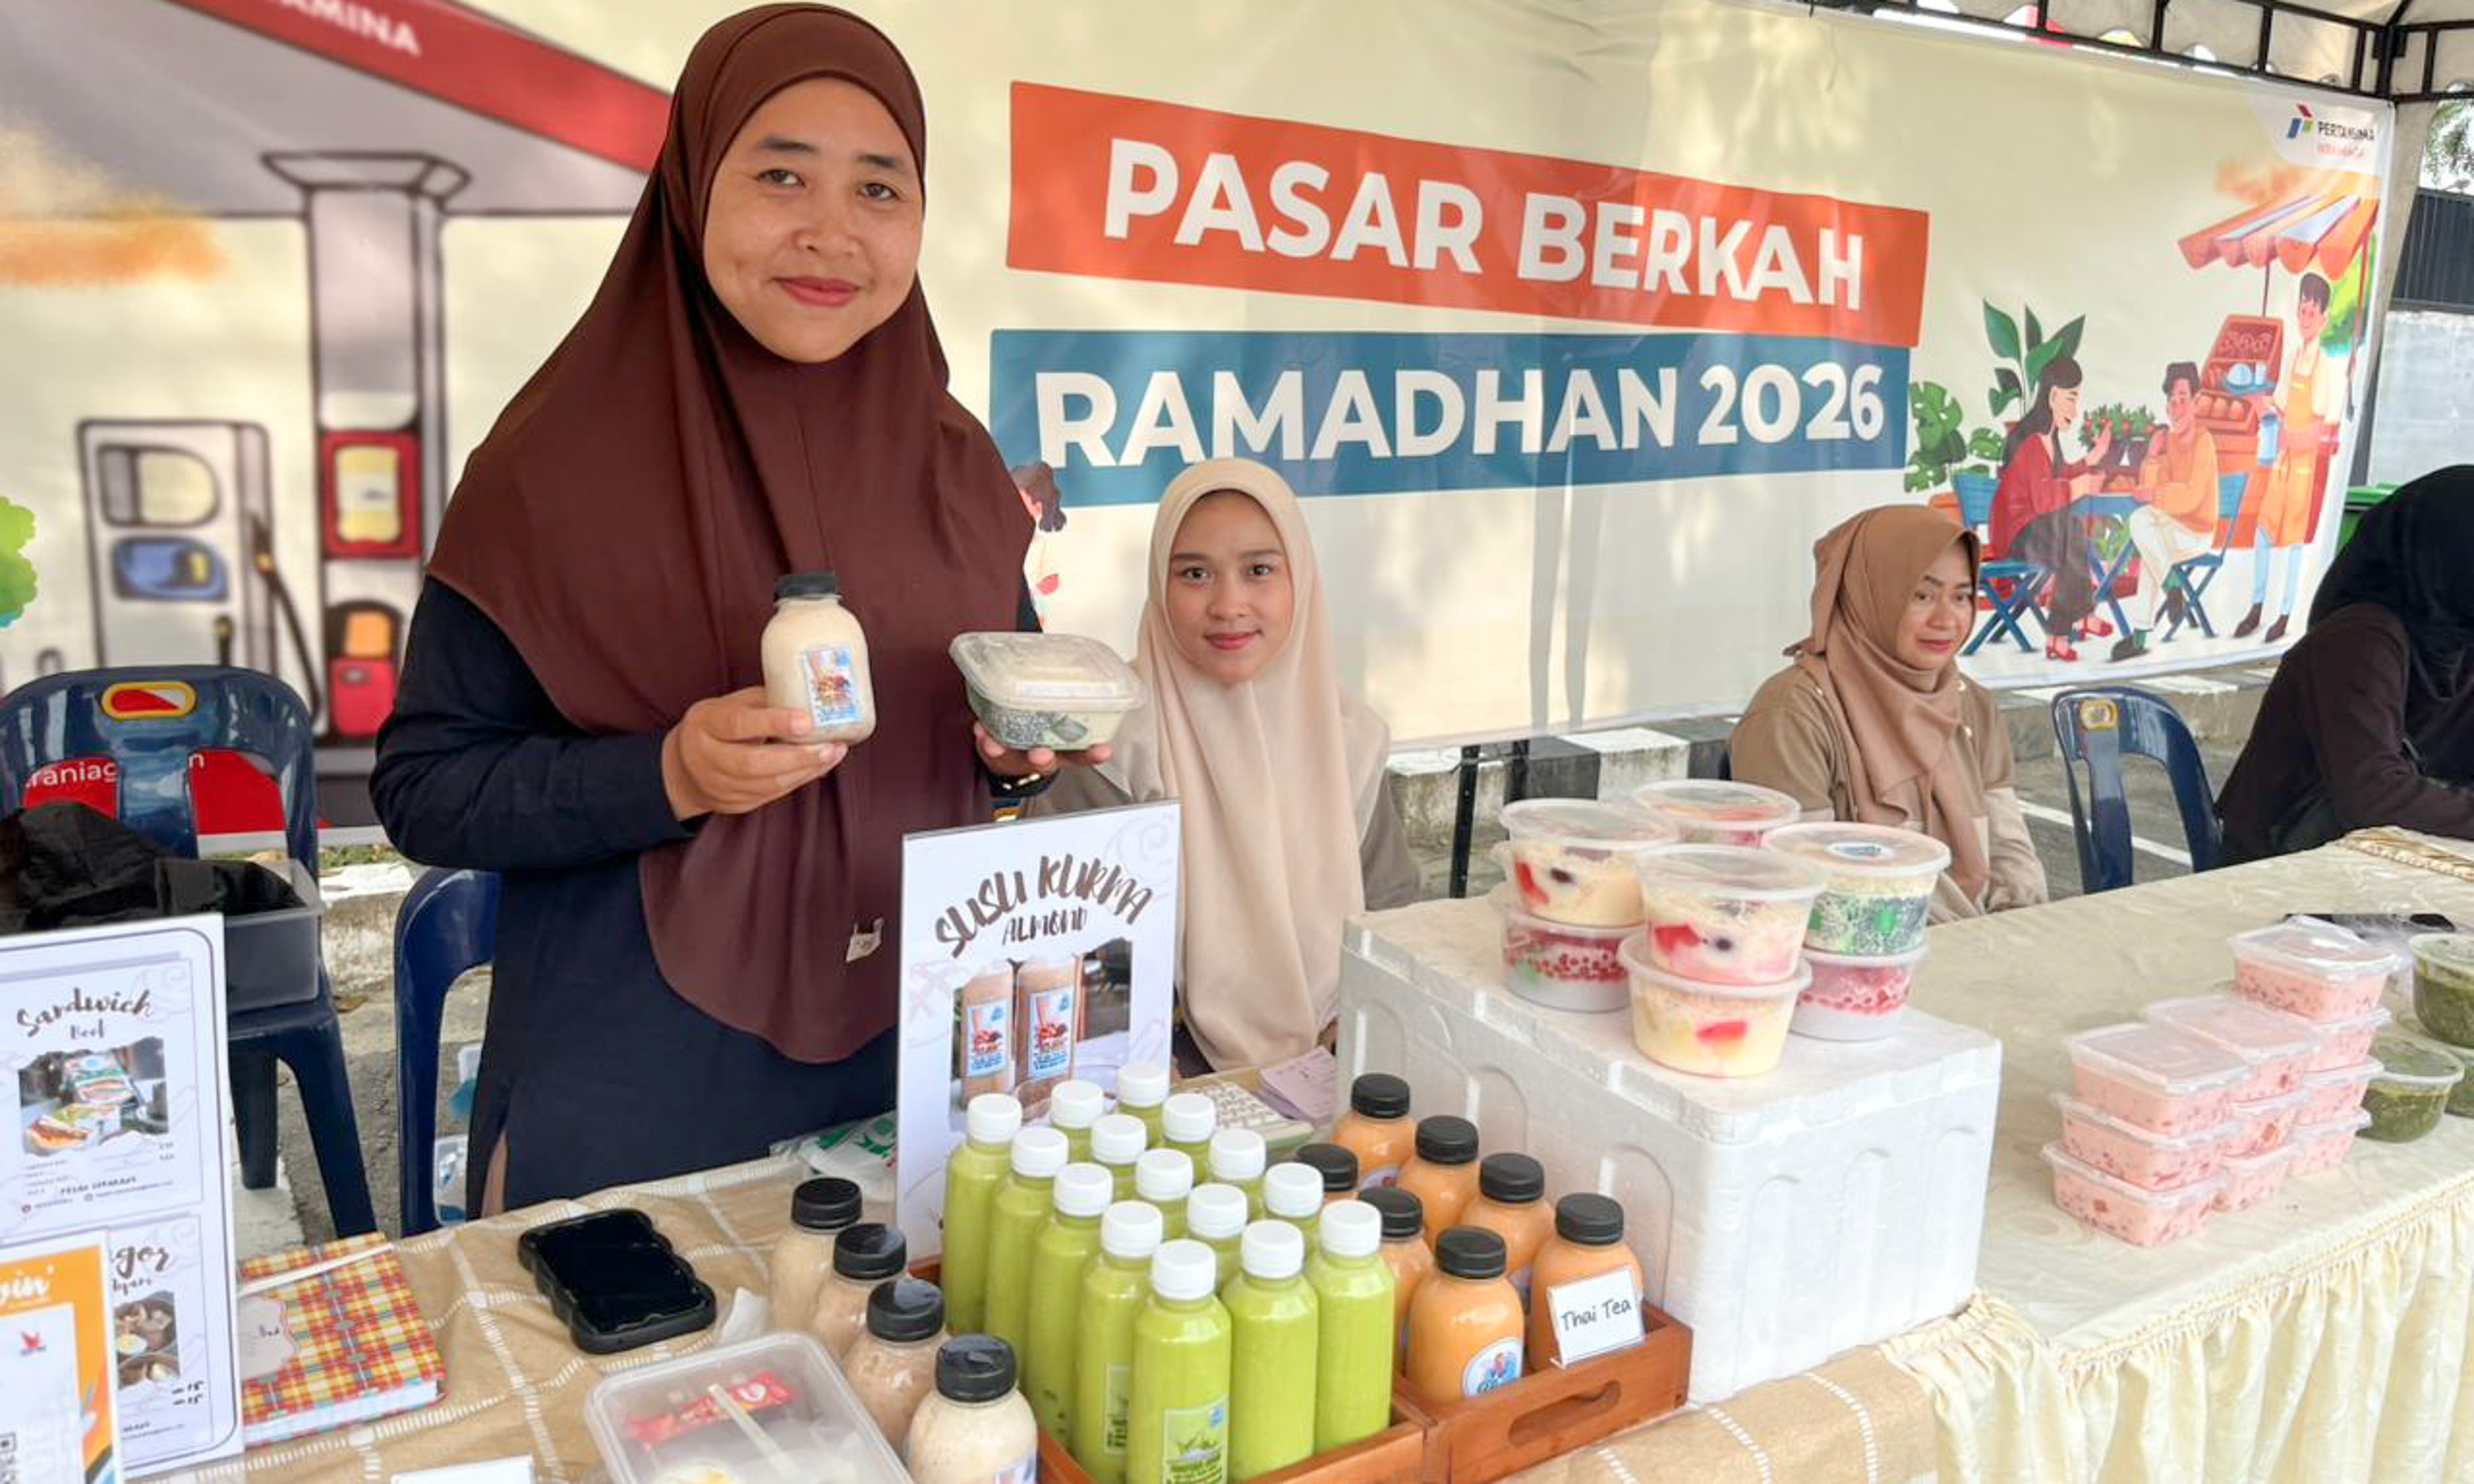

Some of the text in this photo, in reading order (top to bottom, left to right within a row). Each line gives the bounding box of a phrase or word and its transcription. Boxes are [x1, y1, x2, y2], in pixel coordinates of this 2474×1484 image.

[1104, 138, 1862, 310] PASAR BERKAH
[1035, 362, 1884, 468] RAMADHAN 2026
[935, 853, 1153, 958] SUSU KURMA
[17, 986, 156, 1037] Sandwich
[1561, 1298, 1632, 1331] Thai Tea
